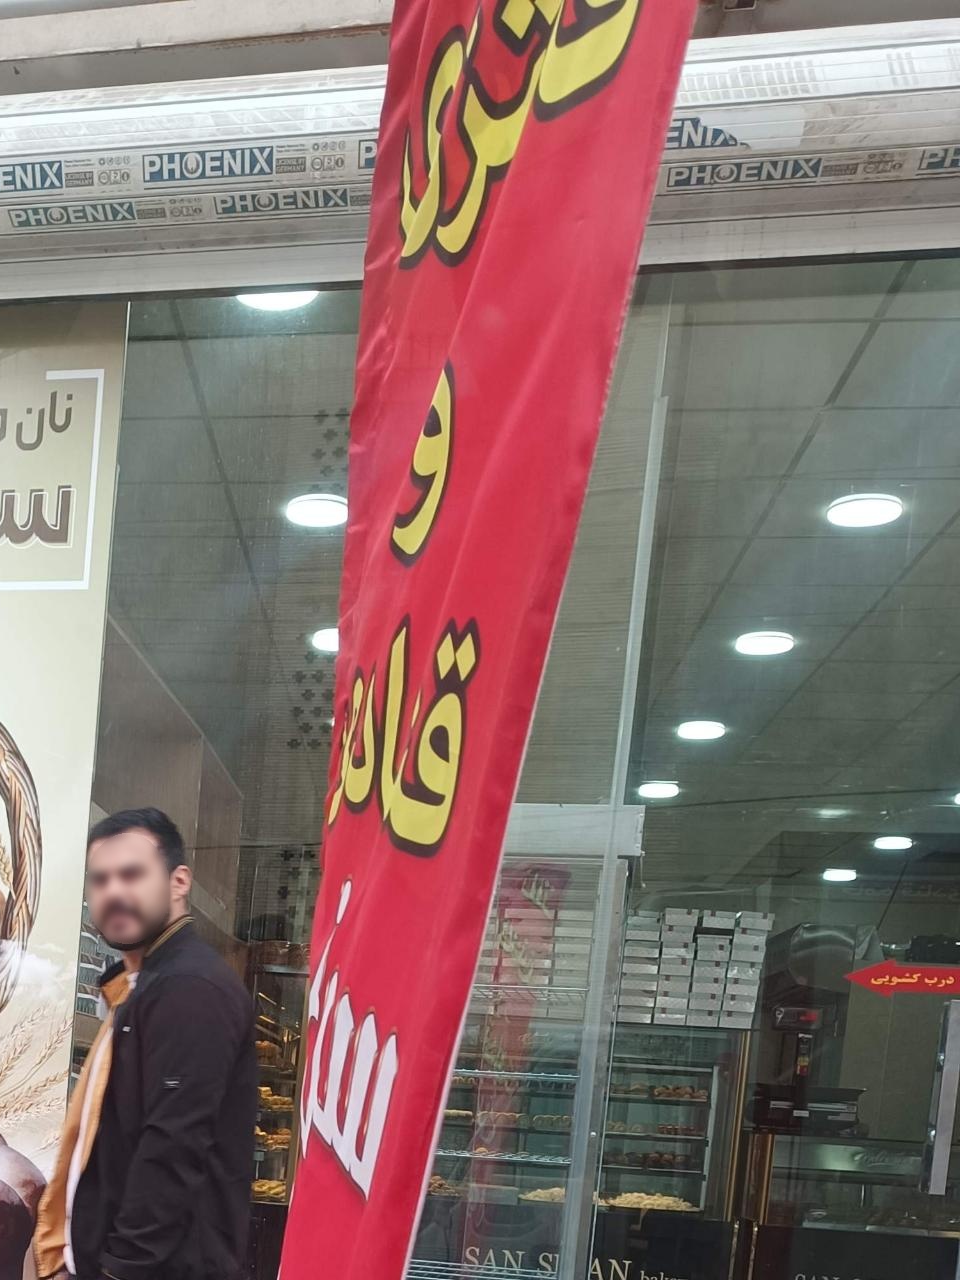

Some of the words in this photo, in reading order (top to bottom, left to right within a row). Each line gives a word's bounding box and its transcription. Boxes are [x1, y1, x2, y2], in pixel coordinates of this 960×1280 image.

[664, 117, 737, 149] ENIX
[144, 146, 273, 182] PHOENIX
[669, 158, 822, 187] PHOENIX
[10, 202, 136, 228] PHOENIX
[216, 189, 349, 214] PHOENIX
[15, 391, 73, 451] نان
[390, 358, 455, 568] و
[870, 972, 921, 986] کشویی
[924, 975, 955, 987] درب
[464, 1247, 526, 1275] SAN
